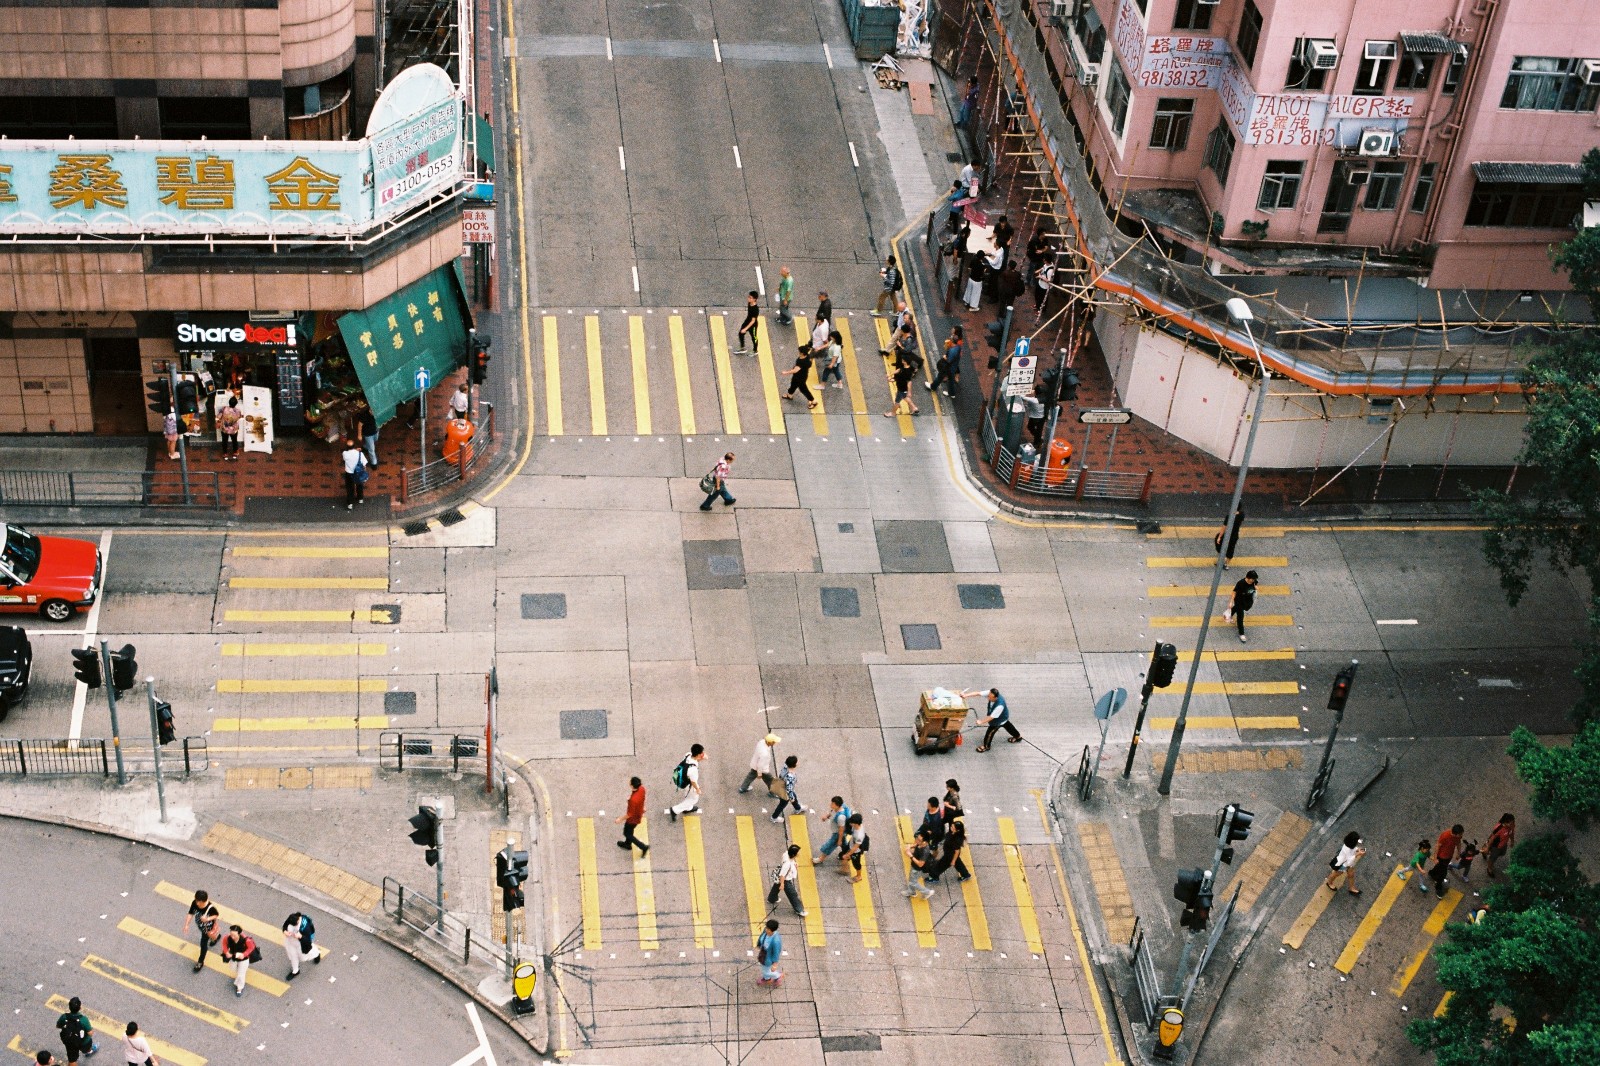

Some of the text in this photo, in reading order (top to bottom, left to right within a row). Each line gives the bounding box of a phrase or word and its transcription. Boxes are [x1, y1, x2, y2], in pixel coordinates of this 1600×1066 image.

[1149, 38, 1214, 53] 塔羅牌
[1141, 69, 1208, 87] 98138132
[1256, 95, 1317, 116] TAROT
[1250, 116, 1310, 132] 塔羅牌
[395, 155, 453, 197] 3100-0553
[462, 222, 489, 231] 100%
